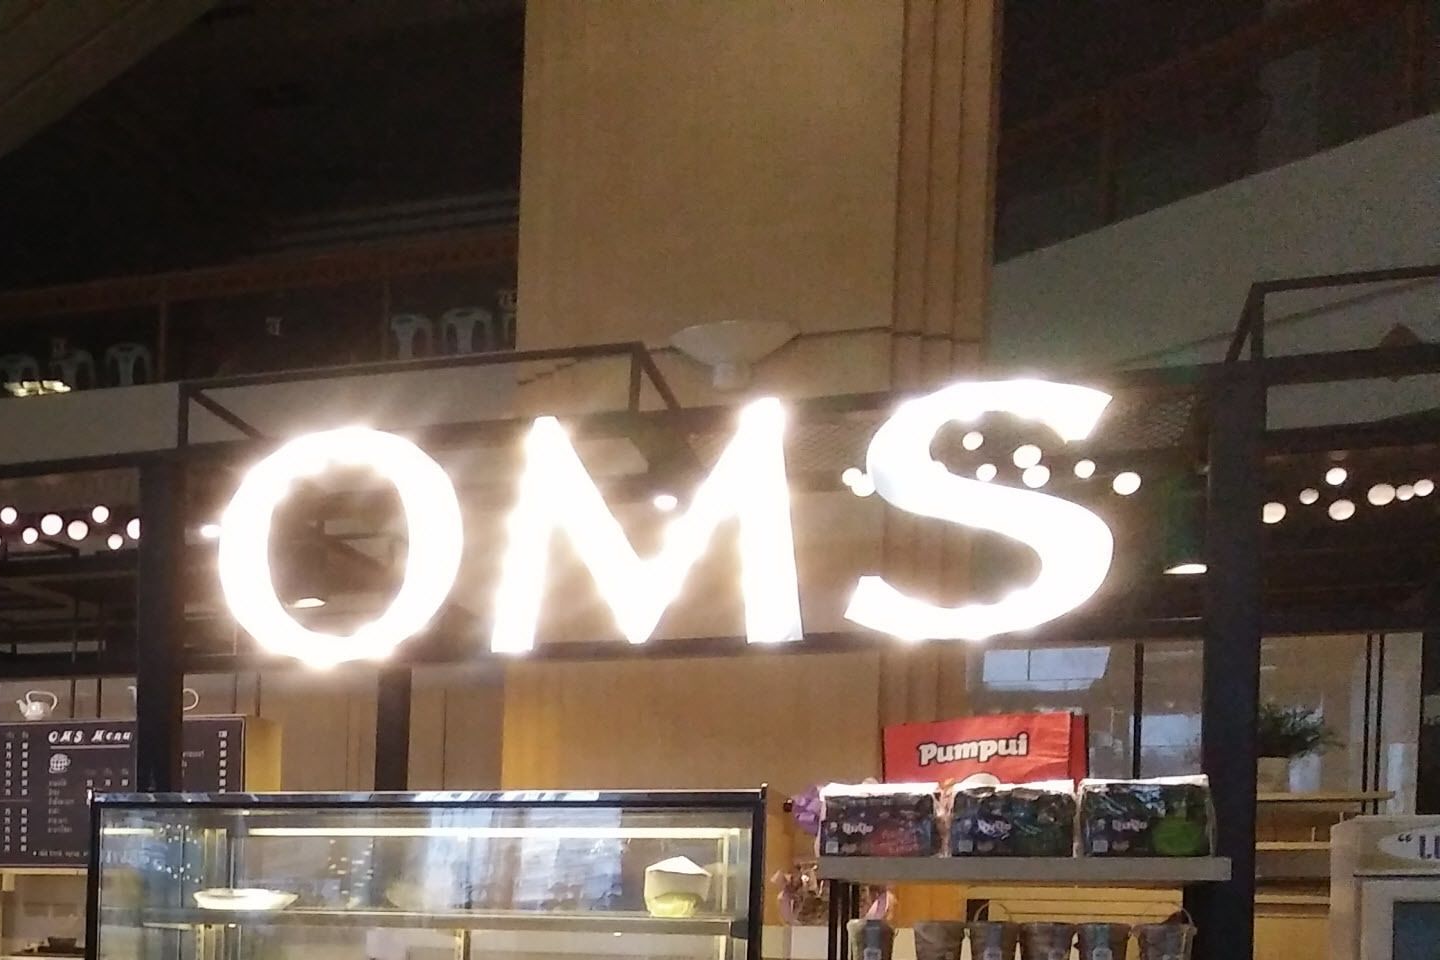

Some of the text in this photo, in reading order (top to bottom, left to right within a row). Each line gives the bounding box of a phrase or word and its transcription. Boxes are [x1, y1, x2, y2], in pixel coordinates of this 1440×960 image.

[218, 378, 1114, 668] OMS
[48, 729, 131, 743] OMS Menu
[917, 731, 1030, 767] Pumpui
